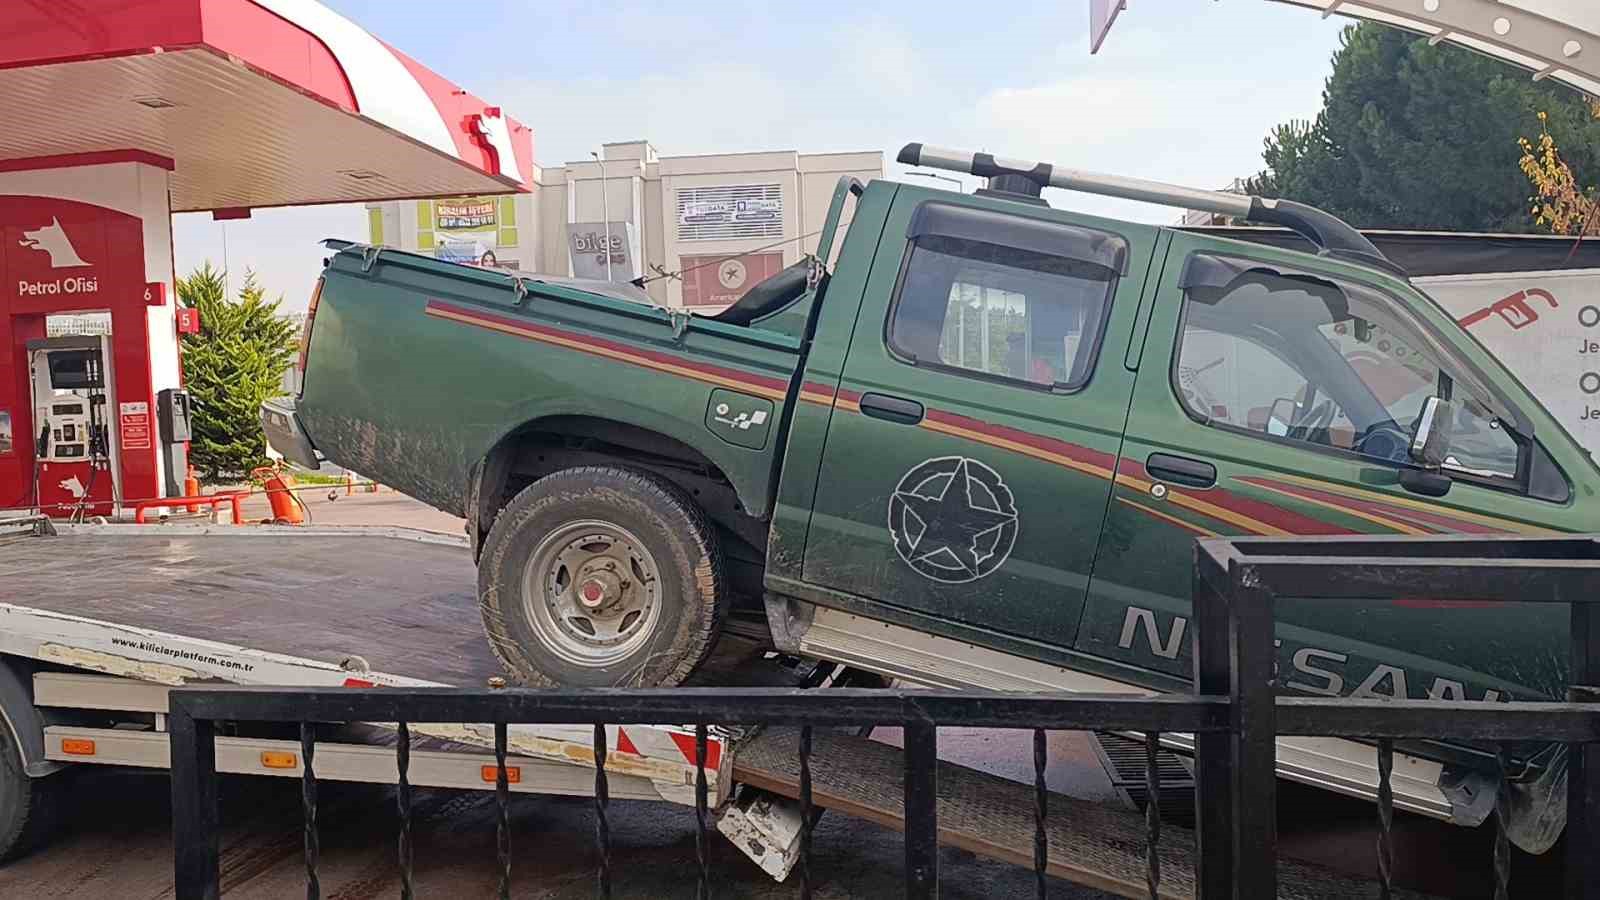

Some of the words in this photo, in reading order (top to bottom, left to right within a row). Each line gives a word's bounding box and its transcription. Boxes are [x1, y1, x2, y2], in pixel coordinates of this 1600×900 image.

[574, 232, 622, 254] bilge
[19, 280, 61, 296] Petrol
[64, 277, 98, 293] Ofisi
[143, 287, 152, 301] 6
[182, 313, 190, 327] 5
[1117, 605, 1502, 701] NSA
